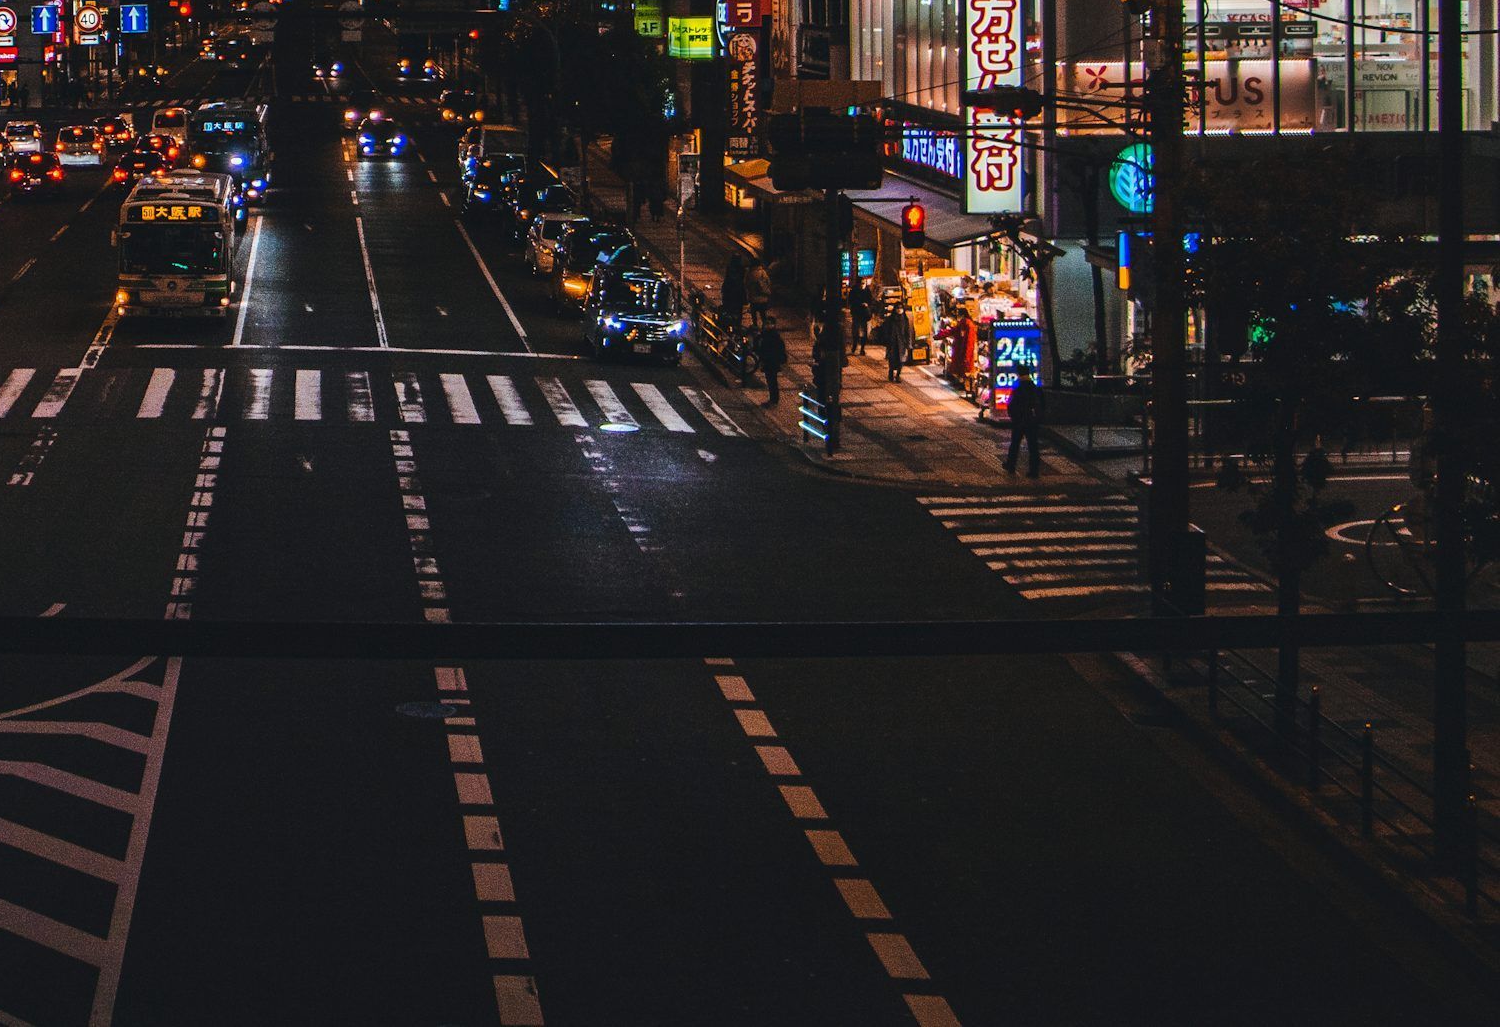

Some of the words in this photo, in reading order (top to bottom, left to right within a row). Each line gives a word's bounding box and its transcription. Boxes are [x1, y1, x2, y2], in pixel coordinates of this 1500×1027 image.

[80, 13, 96, 24] 40
[642, 22, 658, 33] 1F
[1362, 73, 1398, 81] REVLON
[156, 206, 202, 218] 大阪駅
